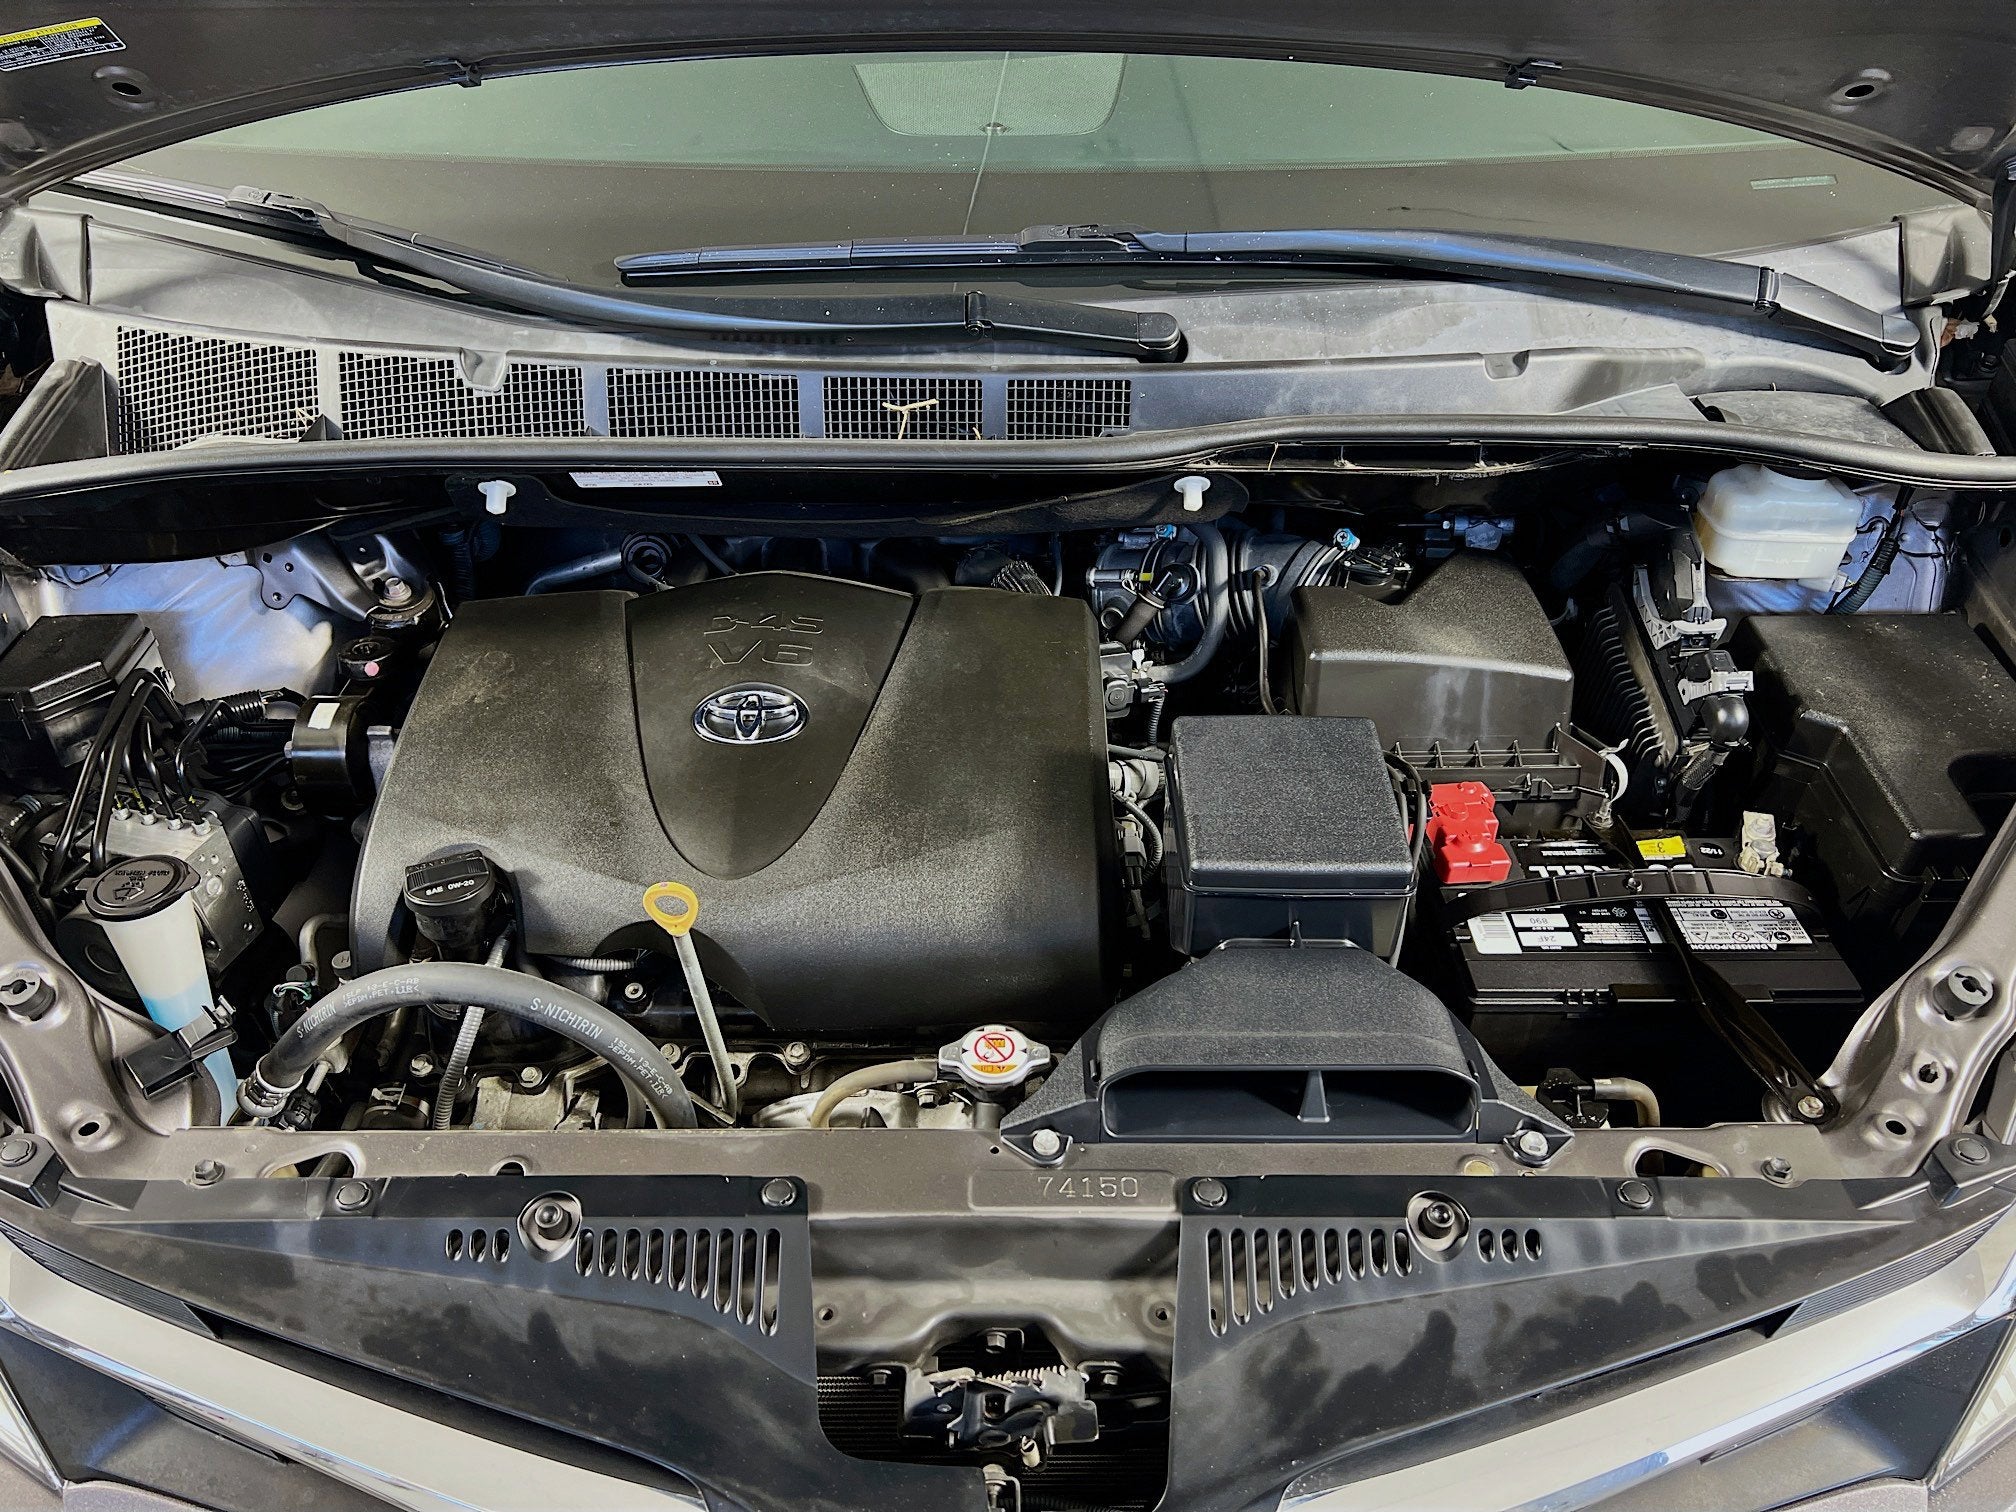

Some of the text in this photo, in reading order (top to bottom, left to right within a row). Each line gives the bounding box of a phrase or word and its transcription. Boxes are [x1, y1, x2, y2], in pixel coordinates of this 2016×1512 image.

[425, 879, 475, 896] SAE 0W-20
[1529, 917, 1548, 925] 890
[1037, 1176, 1139, 1198] 74150
